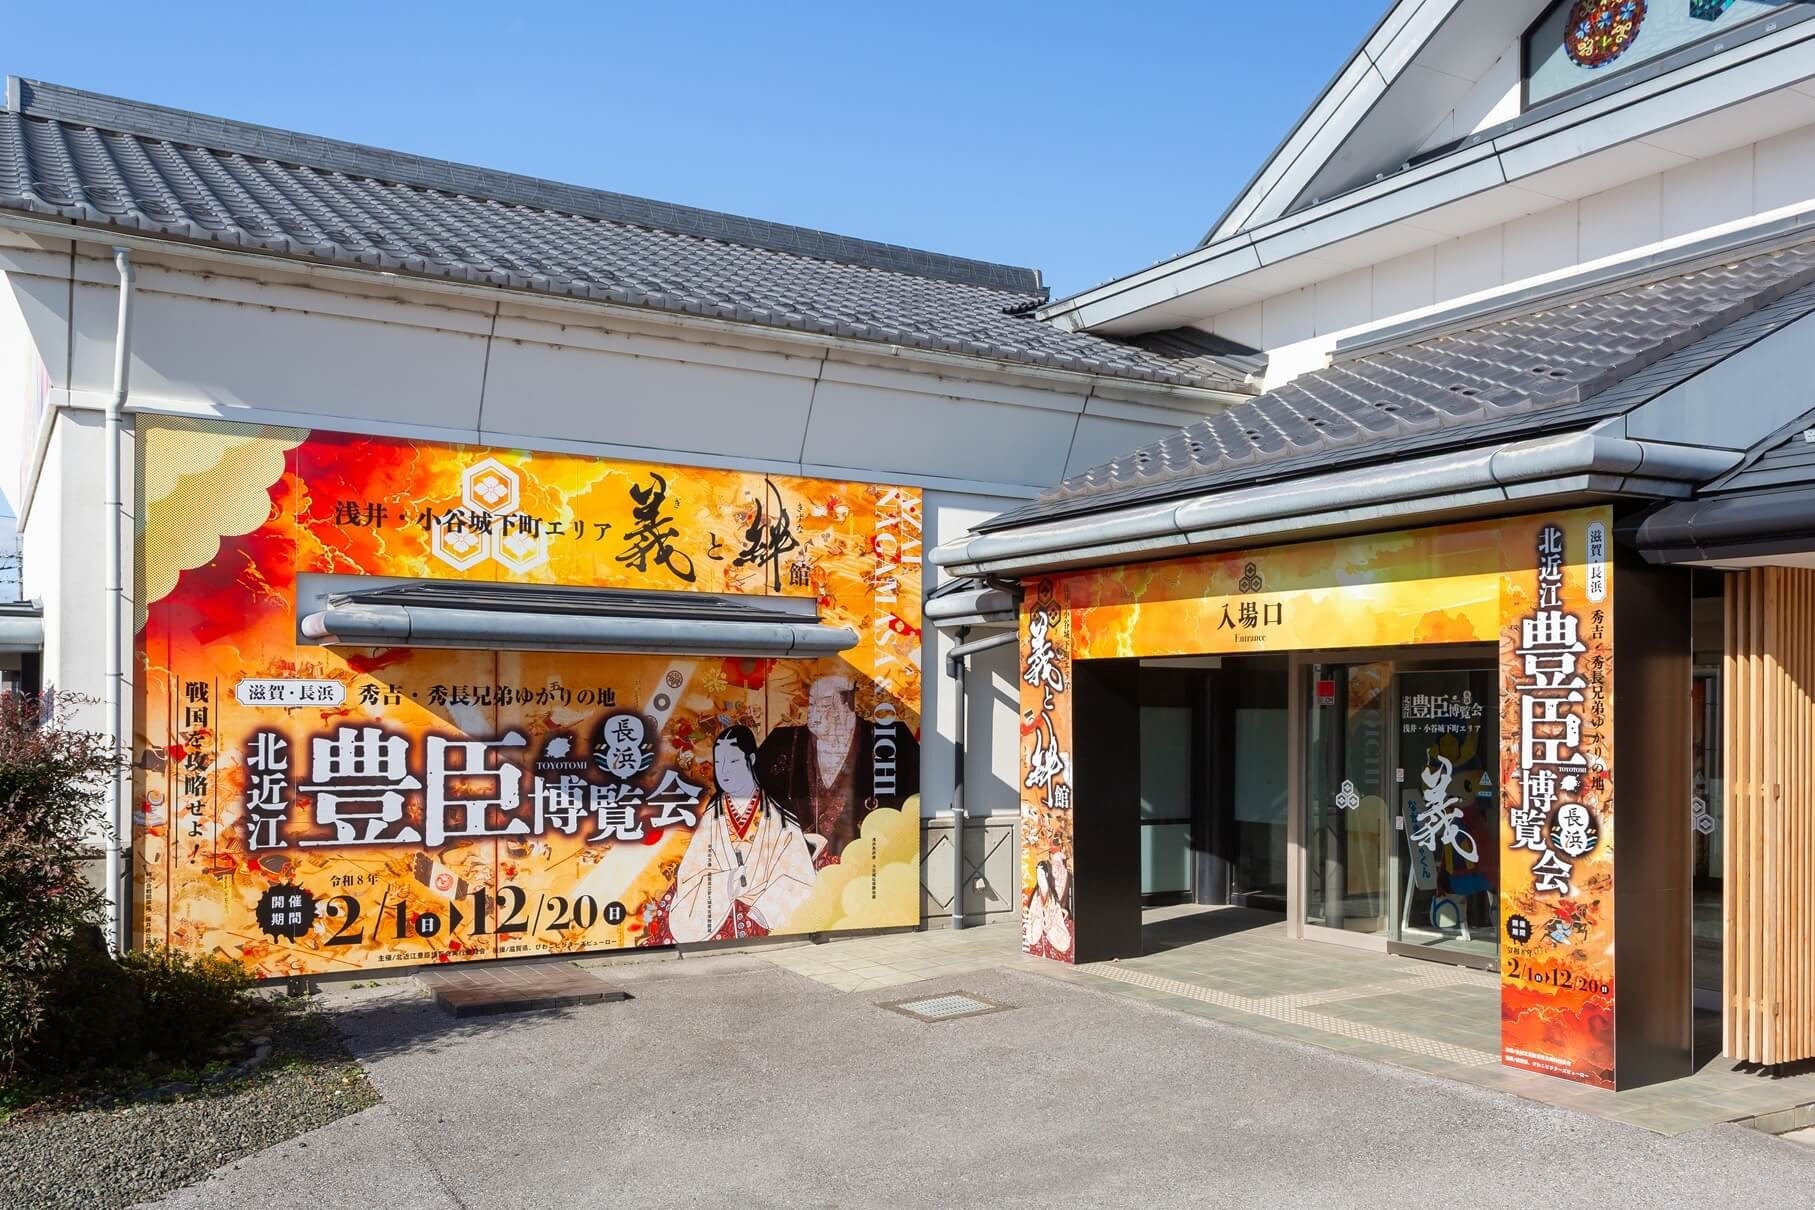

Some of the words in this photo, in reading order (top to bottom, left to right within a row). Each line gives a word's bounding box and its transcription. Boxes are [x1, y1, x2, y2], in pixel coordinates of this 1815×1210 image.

[335, 501, 612, 542] 浅井・小谷城下町エリア
[874, 484, 898, 670] NAGAMASA
[1538, 527, 1563, 609] 北近江
[1589, 530, 1603, 594] 滋賀・長浜
[1217, 601, 1283, 630] 入場口
[1234, 633, 1267, 643] Entrance
[248, 684, 335, 703] 滋賀・長浜
[359, 683, 617, 708] 秀吉・秀長兄弟ゆかりの地
[1590, 609, 1605, 792] 秀吉・秀長兄弟ゆかりの地
[611, 718, 638, 770] 長浜
[873, 702, 897, 797] OICHI
[536, 762, 588, 770] TOYOTOMI
[246, 732, 289, 851] 北近江
[1563, 807, 1584, 849] 長浜
[330, 873, 379, 887] 令和8年
[271, 895, 303, 909] 開催
[271, 912, 302, 926] 期間
[324, 890, 407, 946] 2/1
[465, 885, 598, 936] 12/20
[1552, 967, 1598, 993] 12/20
